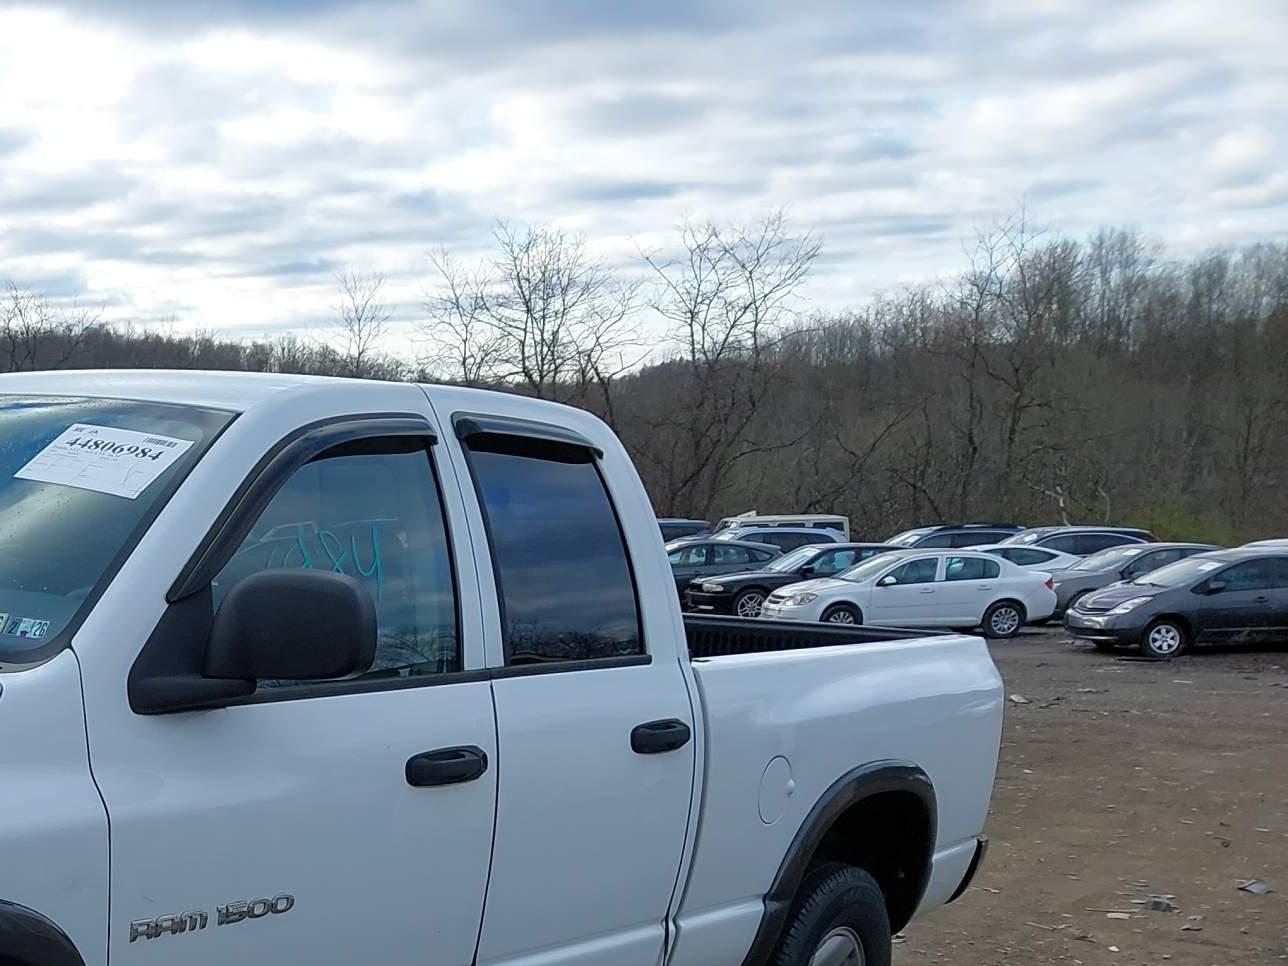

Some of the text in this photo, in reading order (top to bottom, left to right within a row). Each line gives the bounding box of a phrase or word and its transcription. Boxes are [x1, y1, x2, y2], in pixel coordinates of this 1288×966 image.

[65, 436, 164, 461] 44806984
[129, 893, 295, 943] RAM 1500
